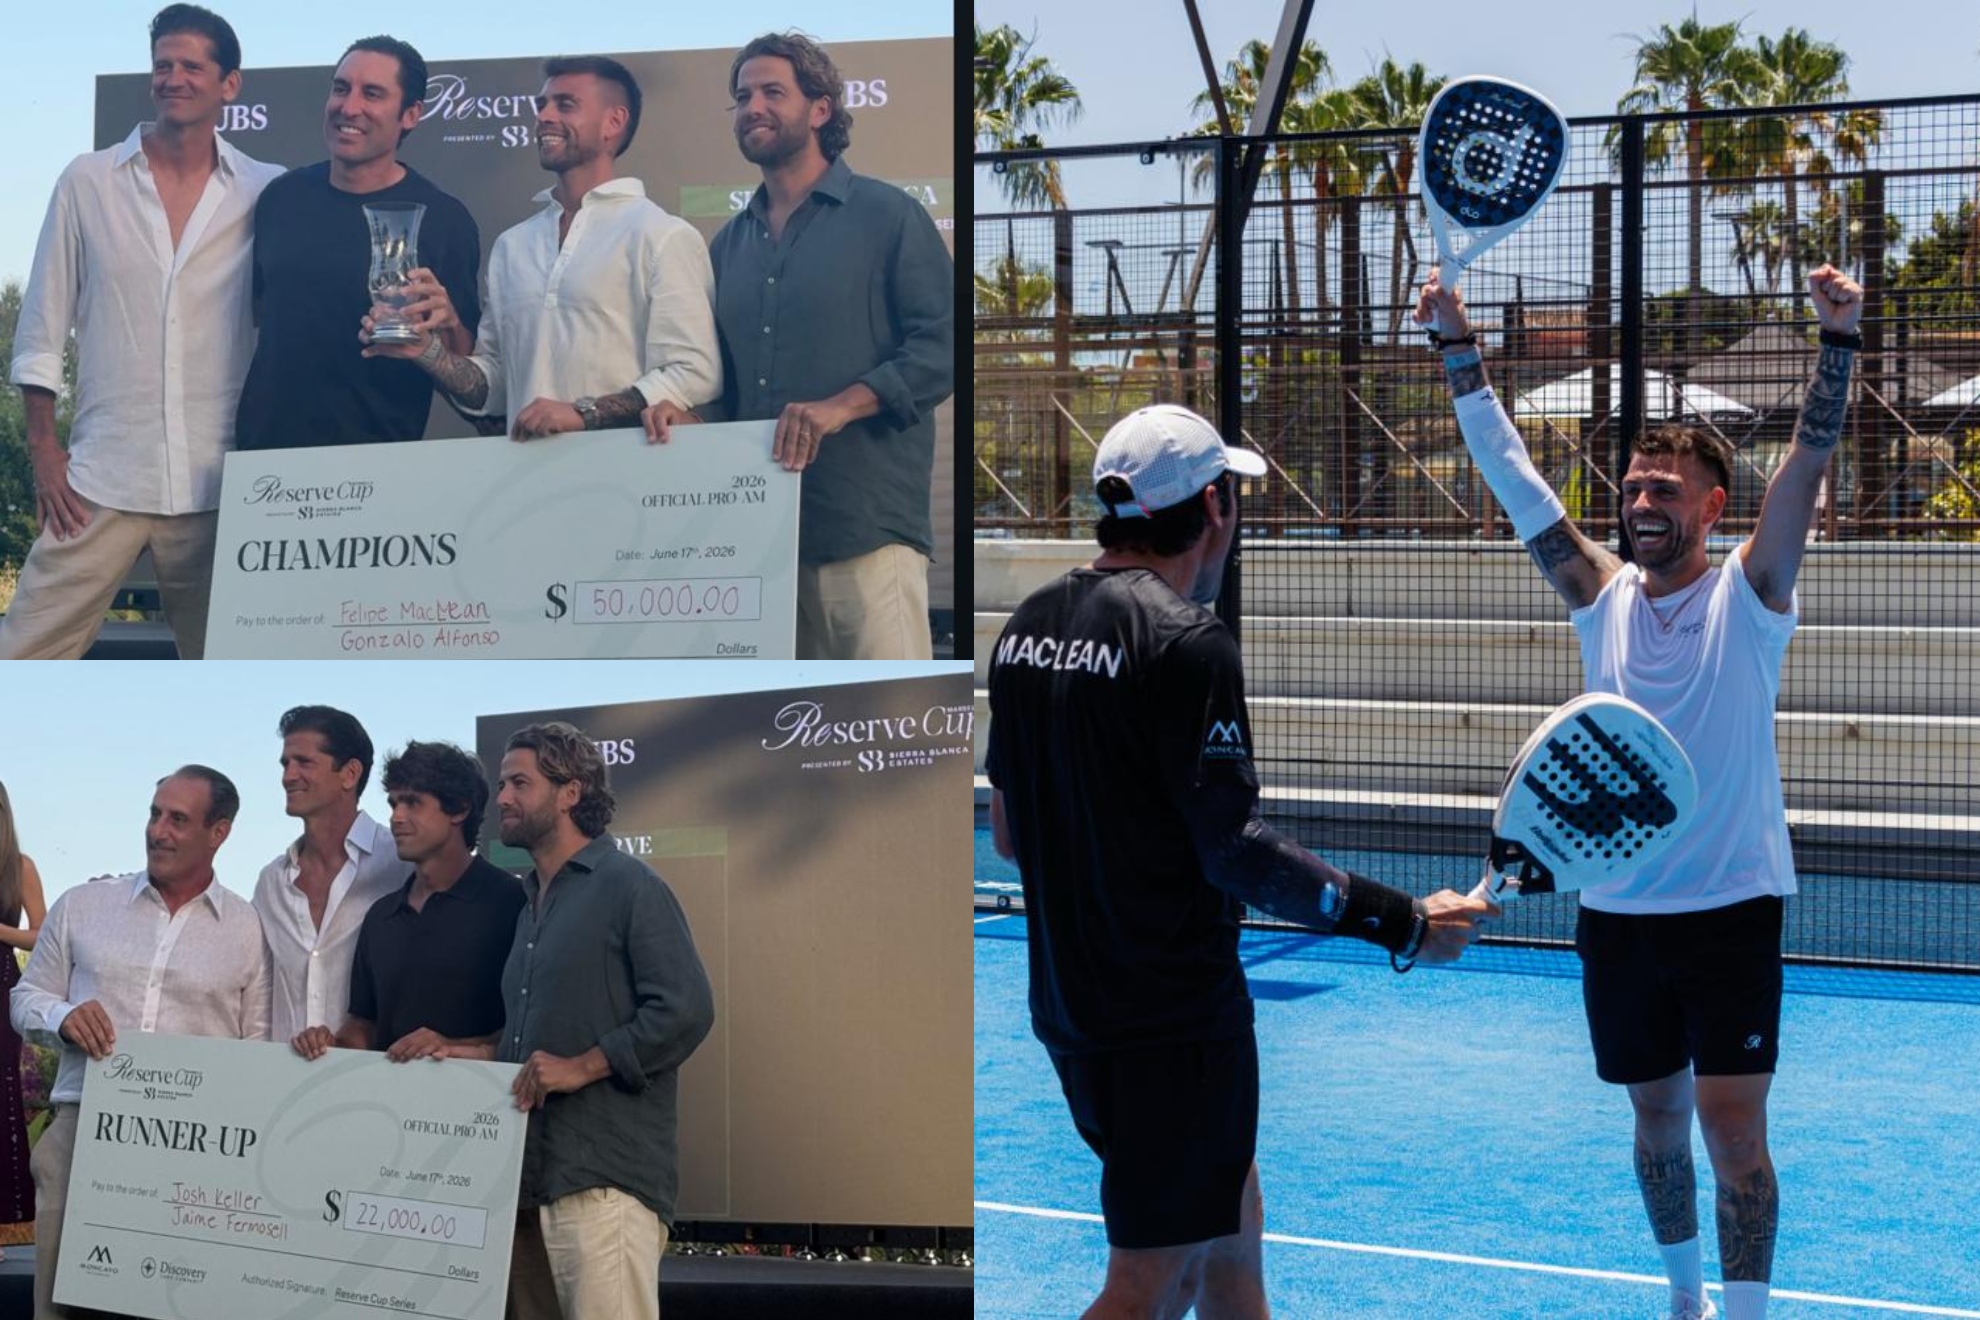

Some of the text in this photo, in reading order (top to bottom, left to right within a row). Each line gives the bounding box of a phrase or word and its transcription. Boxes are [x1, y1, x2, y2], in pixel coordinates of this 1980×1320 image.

[243, 474, 375, 505] Reserve Cup
[731, 475, 766, 488] 2026
[641, 490, 766, 508] OFFICIAL PRO AM
[237, 532, 458, 573] CHAMPIONS
[649, 548, 678, 560] June
[704, 545, 736, 558] 2026
[545, 582, 568, 623] $
[592, 583, 740, 617] 50,000.00
[235, 615, 254, 628] Pay
[256, 616, 266, 626] to
[267, 614, 284, 626] the
[285, 614, 312, 625] order
[340, 600, 390, 627] Felipe
[340, 628, 500, 651] Gonzalo Alfonso
[716, 643, 758, 655] Dollars
[996, 634, 1123, 678] MACLEAN
[761, 700, 917, 751] Reserve
[801, 760, 841, 769] PRESENTED
[888, 746, 970, 760] SIERRA BLANCA
[888, 757, 934, 768] ESTATES
[103, 1053, 204, 1091] Reserve Cup
[403, 1119, 499, 1141] OFFICIAL PRO AM
[472, 1111, 500, 1127] 2026
[94, 1112, 257, 1158] RUNNER-UP
[405, 1170, 428, 1182] June
[447, 1174, 471, 1187] 2026
[172, 1182, 263, 1211] Josh Keller
[322, 1189, 342, 1227] $
[172, 1206, 289, 1241] Jaime Fermosell
[356, 1201, 457, 1240] 22,000.00
[160, 1260, 207, 1282] Discovery
[241, 1273, 285, 1290] Authorized
[448, 1264, 479, 1280] Dollars
[335, 1287, 416, 1310] Reserve Cup Series
